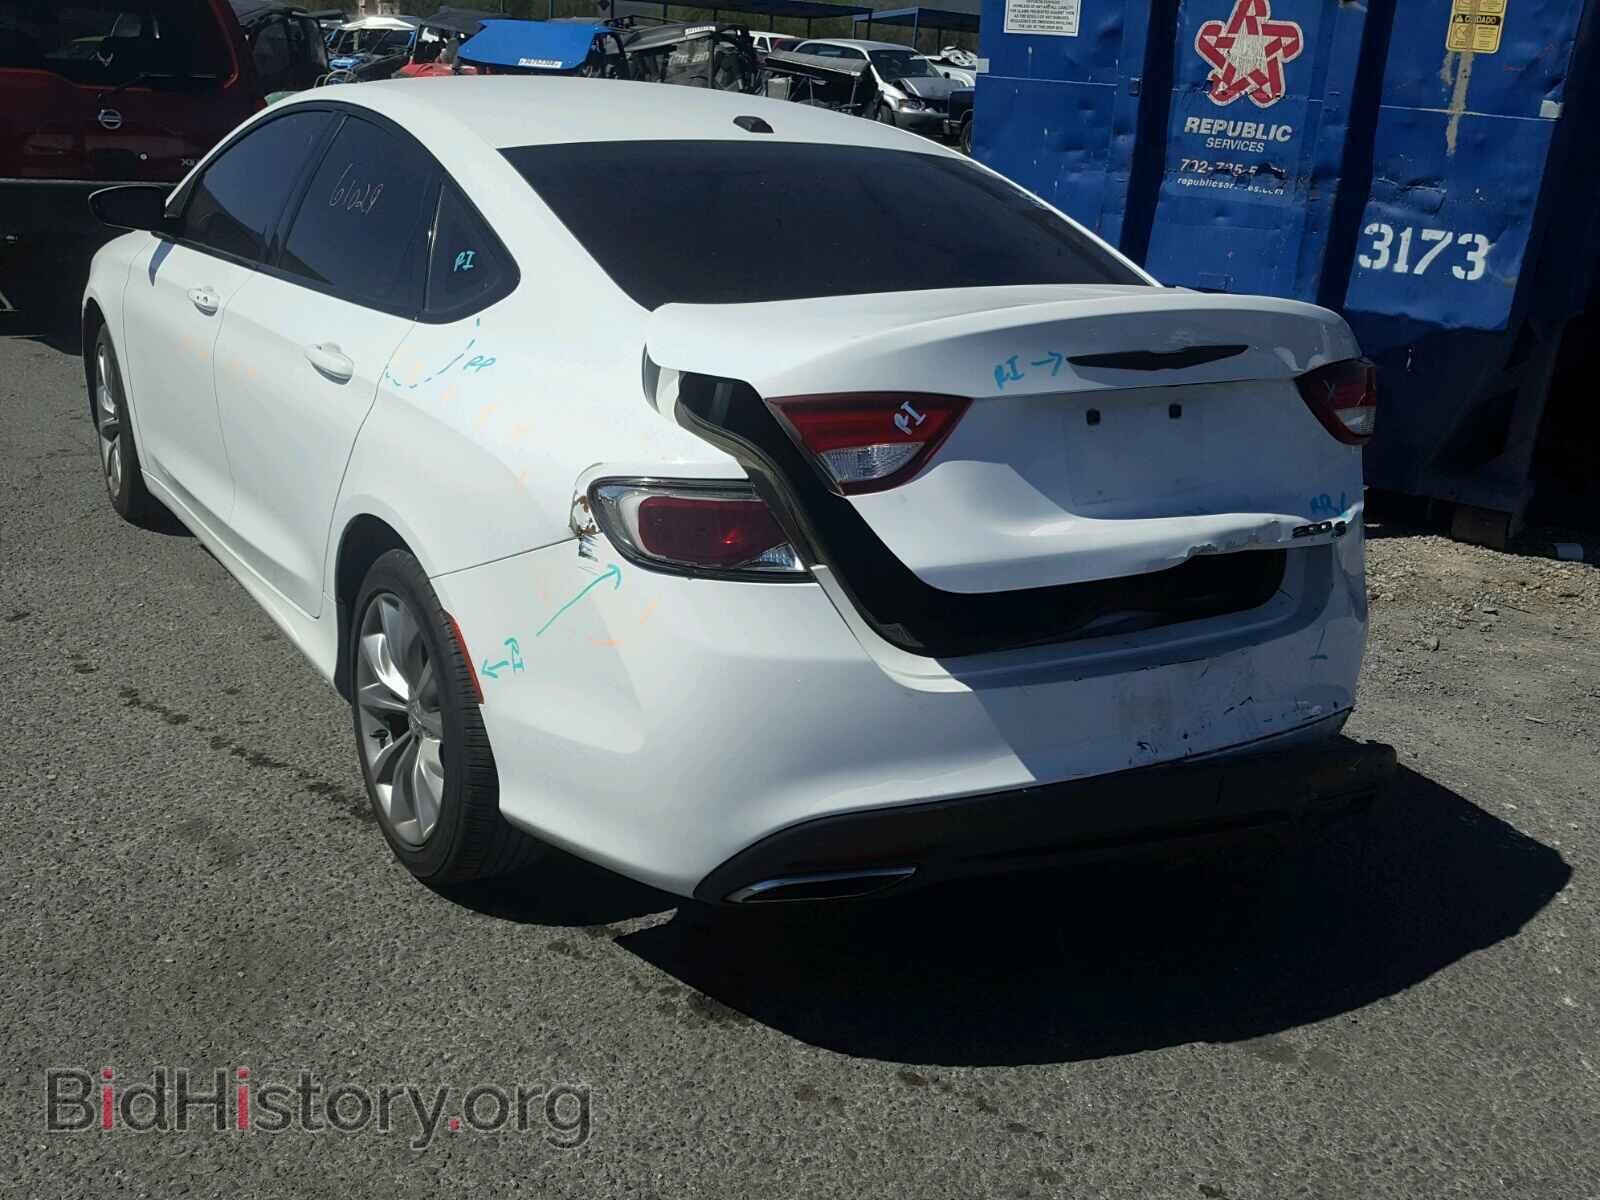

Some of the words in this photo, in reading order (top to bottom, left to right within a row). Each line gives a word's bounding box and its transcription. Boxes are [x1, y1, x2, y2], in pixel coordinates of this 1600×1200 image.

[1184, 116, 1292, 142] REPUBLIC
[1205, 137, 1265, 153] SERVICES
[1358, 223, 1489, 281] 3173
